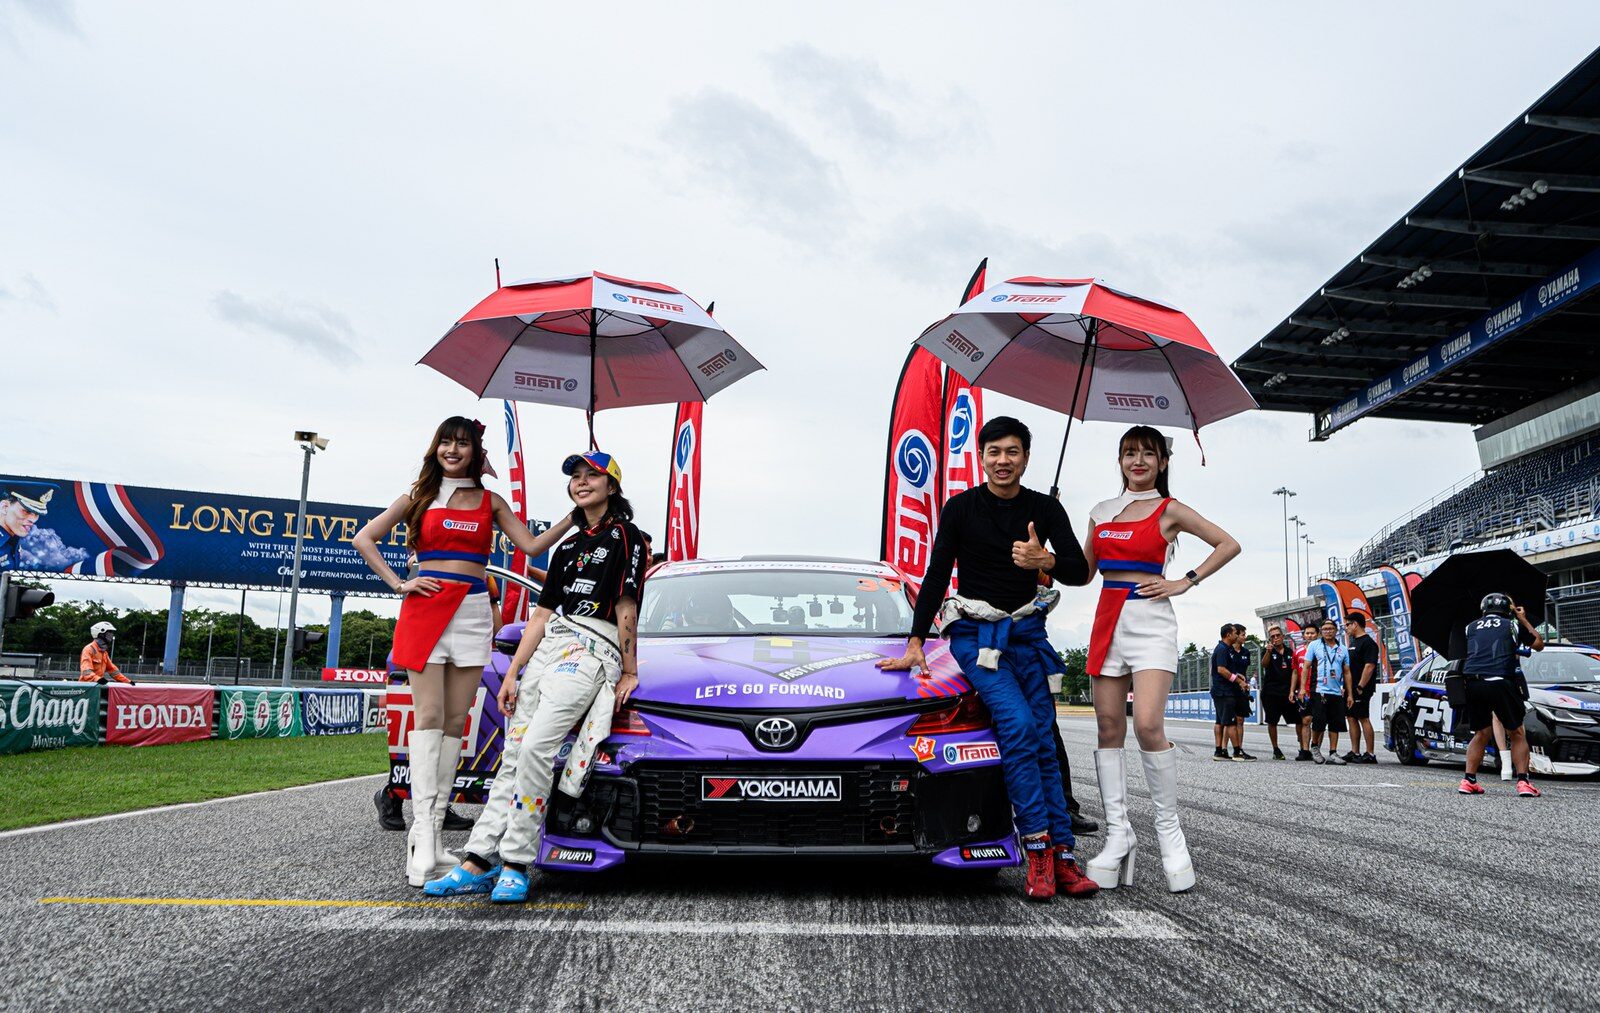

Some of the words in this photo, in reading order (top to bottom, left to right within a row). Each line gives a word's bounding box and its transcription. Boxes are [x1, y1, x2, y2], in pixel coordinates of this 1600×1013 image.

[1547, 267, 1580, 298] YAMAHA
[627, 295, 683, 312] Trane
[1006, 294, 1066, 302] Trane
[1542, 285, 1578, 308] RACING
[1493, 301, 1522, 329] YAMAHA
[1488, 317, 1521, 337] RACING
[1447, 332, 1471, 356] YAMAHA
[1409, 356, 1429, 377] YAMAHA
[169, 503, 275, 536] LONG
[282, 512, 358, 543] LIVE
[452, 521, 477, 531] Trane
[241, 550, 259, 558] AND
[260, 551, 282, 559] TEAM
[335, 557, 363, 565] CHANG
[249, 542, 271, 550] WITH
[272, 543, 289, 551] THE
[290, 544, 323, 553] UMOST
[325, 548, 359, 556] RESPECT
[277, 565, 307, 578] Chag
[310, 570, 363, 580] INTERNATIONAL
[1476, 618, 1501, 629] 243
[778, 665, 808, 680] FAST
[695, 683, 737, 699] LET'S
[742, 683, 764, 695] GO
[768, 683, 845, 700] FORWARD
[10, 685, 90, 735] Chang
[115, 704, 207, 730] HONDA
[319, 695, 359, 724] YAMAHA
[1414, 697, 1453, 733] P1
[310, 726, 357, 736] RACING
[31, 734, 66, 748] MINERAL
[956, 743, 999, 761] Trane
[738, 780, 837, 797] YOKOHAMA
